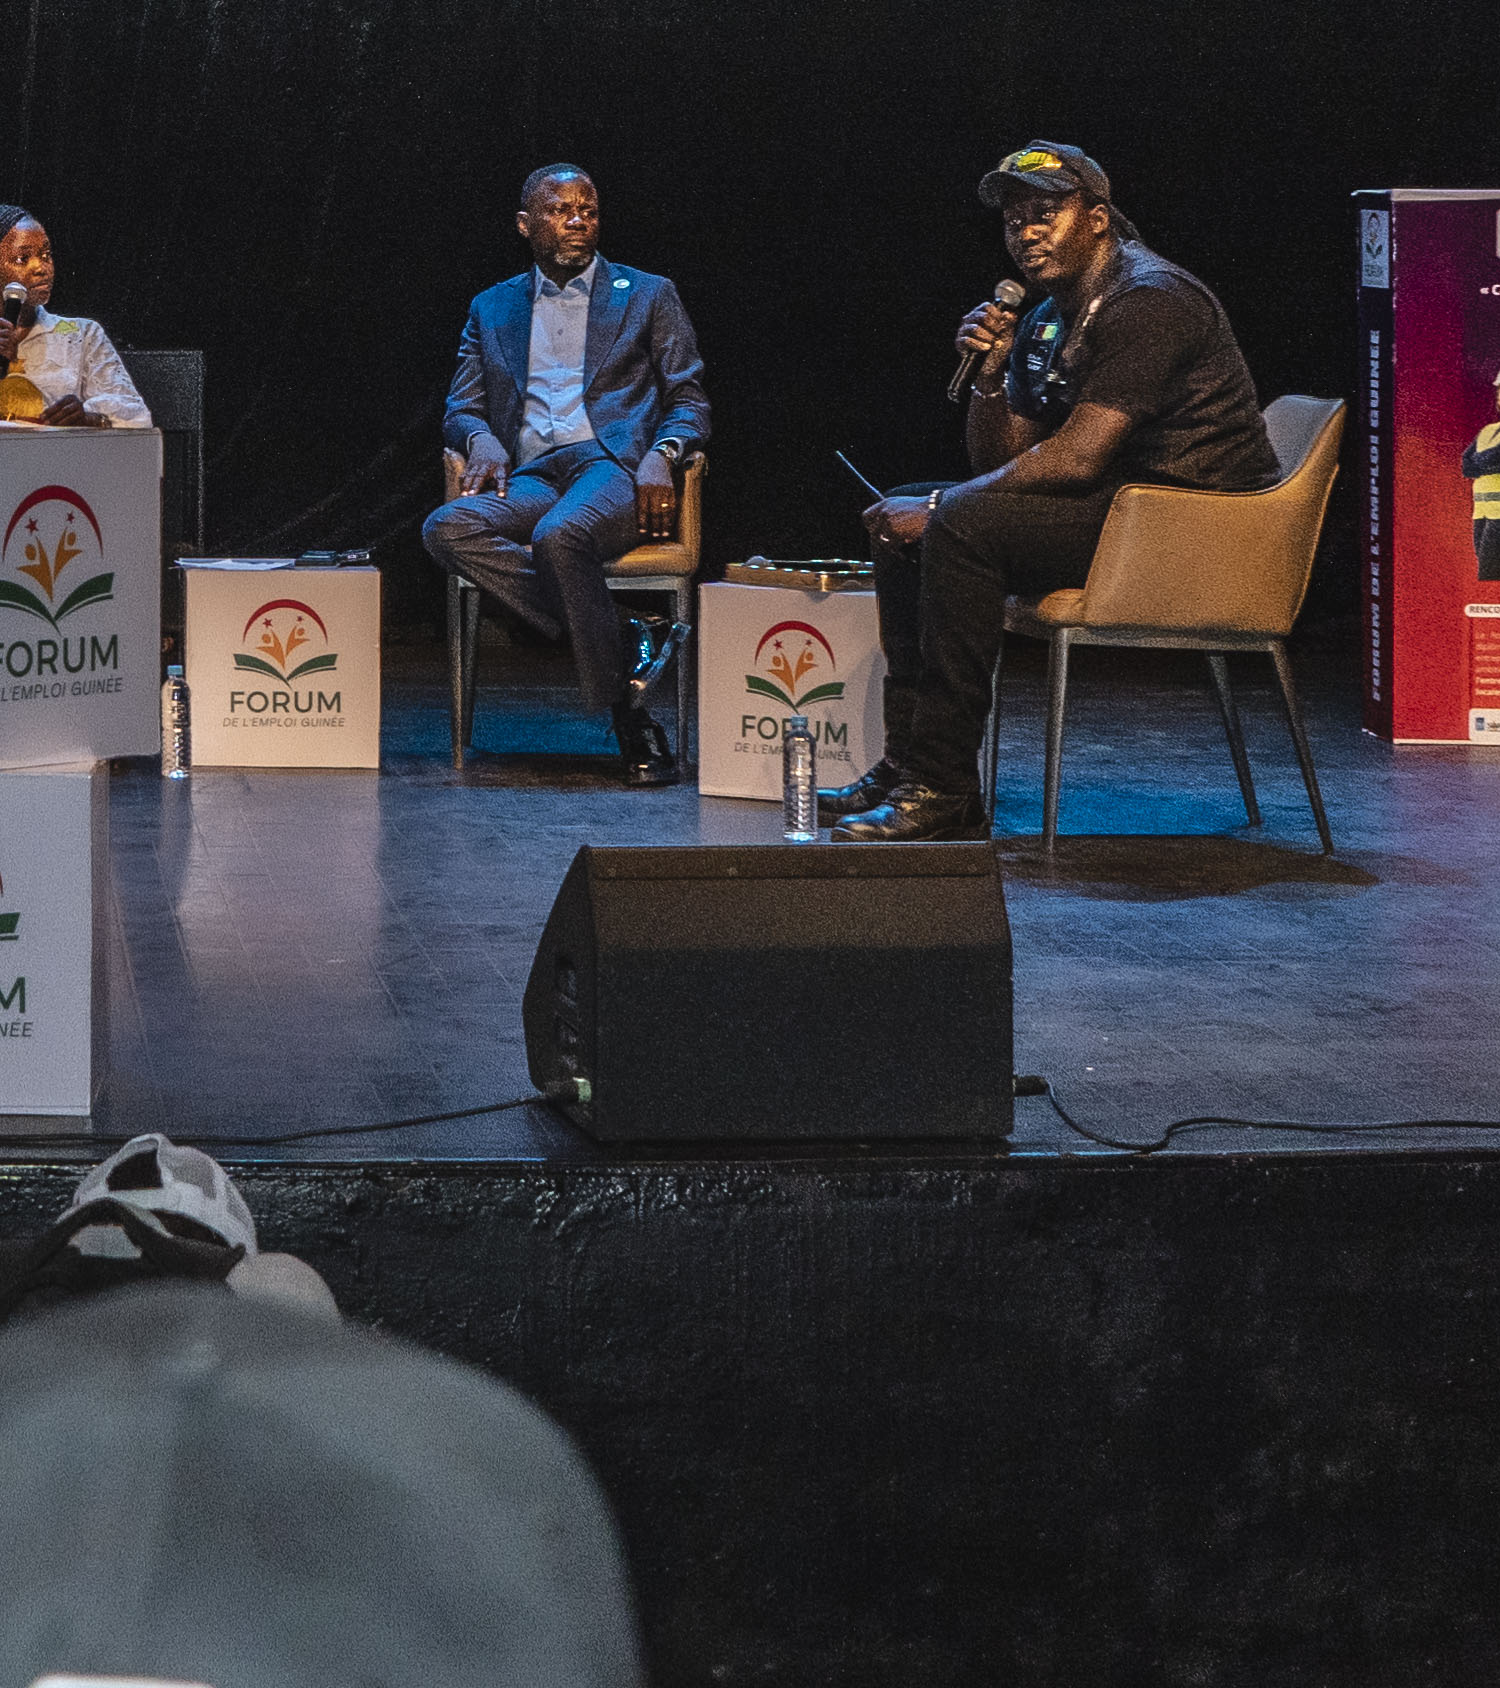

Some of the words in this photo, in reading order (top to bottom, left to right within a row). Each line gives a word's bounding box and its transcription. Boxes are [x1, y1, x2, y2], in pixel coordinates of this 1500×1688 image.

[1, 681, 66, 703] L'EMPLOI
[70, 676, 123, 698] GUINÉE
[229, 691, 343, 714] FORUM
[223, 717, 239, 728] DE
[242, 717, 298, 728] L'EMPLOI
[301, 715, 346, 728] GUINÉE
[734, 742, 750, 752] DE
[816, 747, 852, 762] UINÉE
